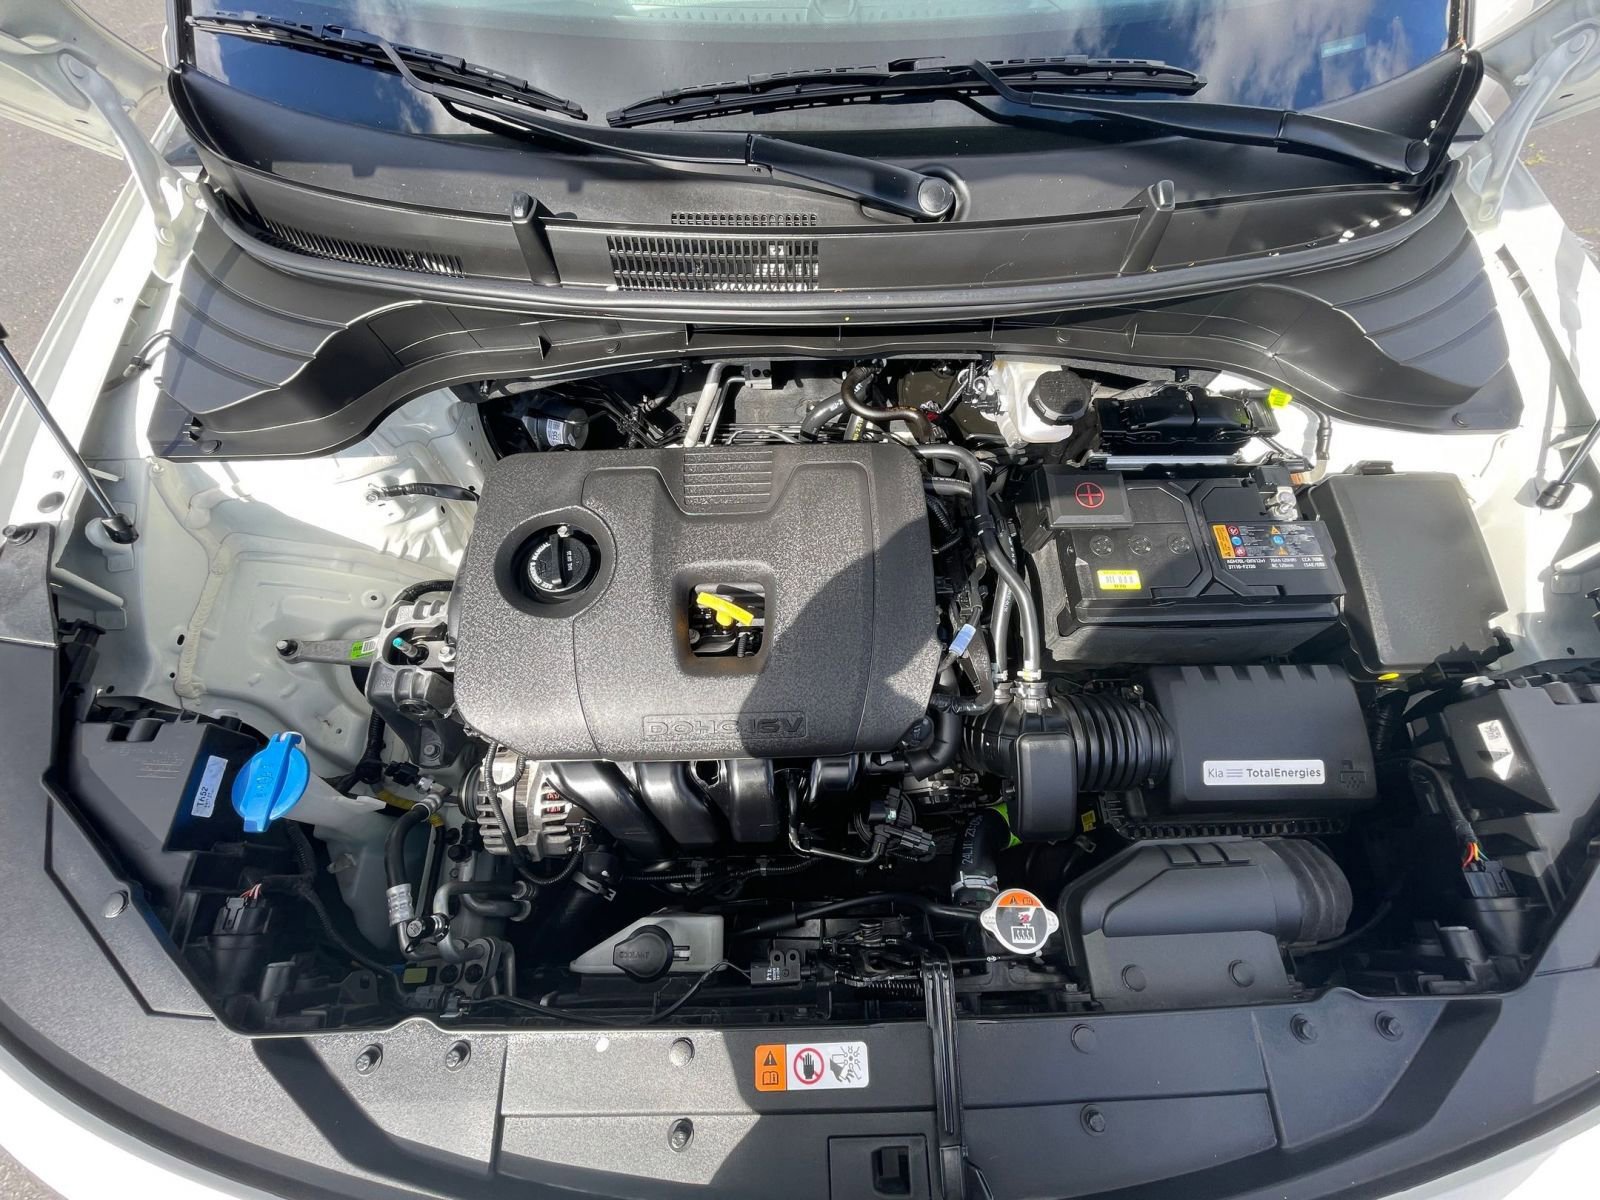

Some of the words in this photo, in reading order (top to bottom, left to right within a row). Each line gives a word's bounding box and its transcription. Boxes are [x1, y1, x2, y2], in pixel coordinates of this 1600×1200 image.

[531, 541, 552, 560] MANUAL
[646, 719, 740, 736] DOHC
[751, 717, 804, 733] 16V
[1208, 768, 1224, 778] Kia
[1246, 768, 1321, 778] TotalEnergies
[618, 951, 650, 960] COOLANT
